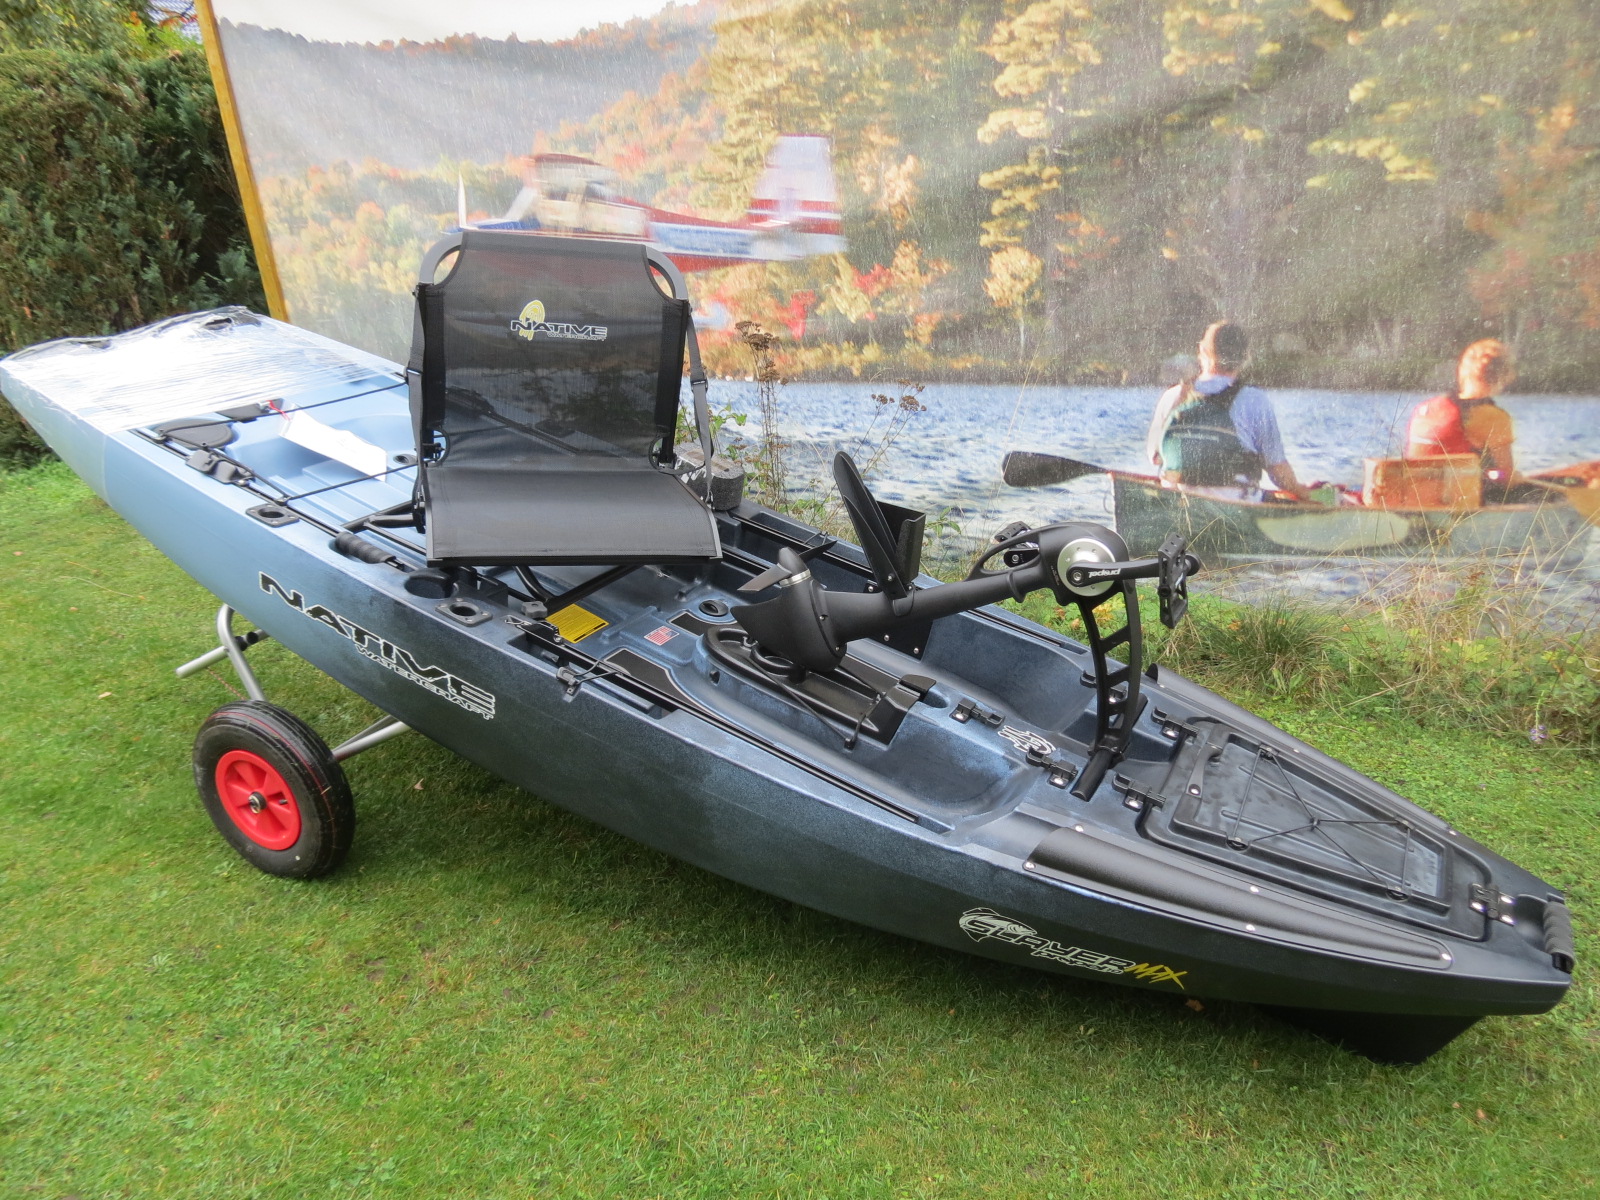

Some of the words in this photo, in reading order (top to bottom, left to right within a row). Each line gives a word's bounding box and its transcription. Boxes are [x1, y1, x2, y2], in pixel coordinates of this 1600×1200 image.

[510, 320, 607, 337] NATIVE
[258, 571, 496, 715] NATIVE
[354, 643, 494, 721] WATERCRAFT
[964, 916, 1136, 972] SLAYER
[1124, 962, 1188, 990] MAX
